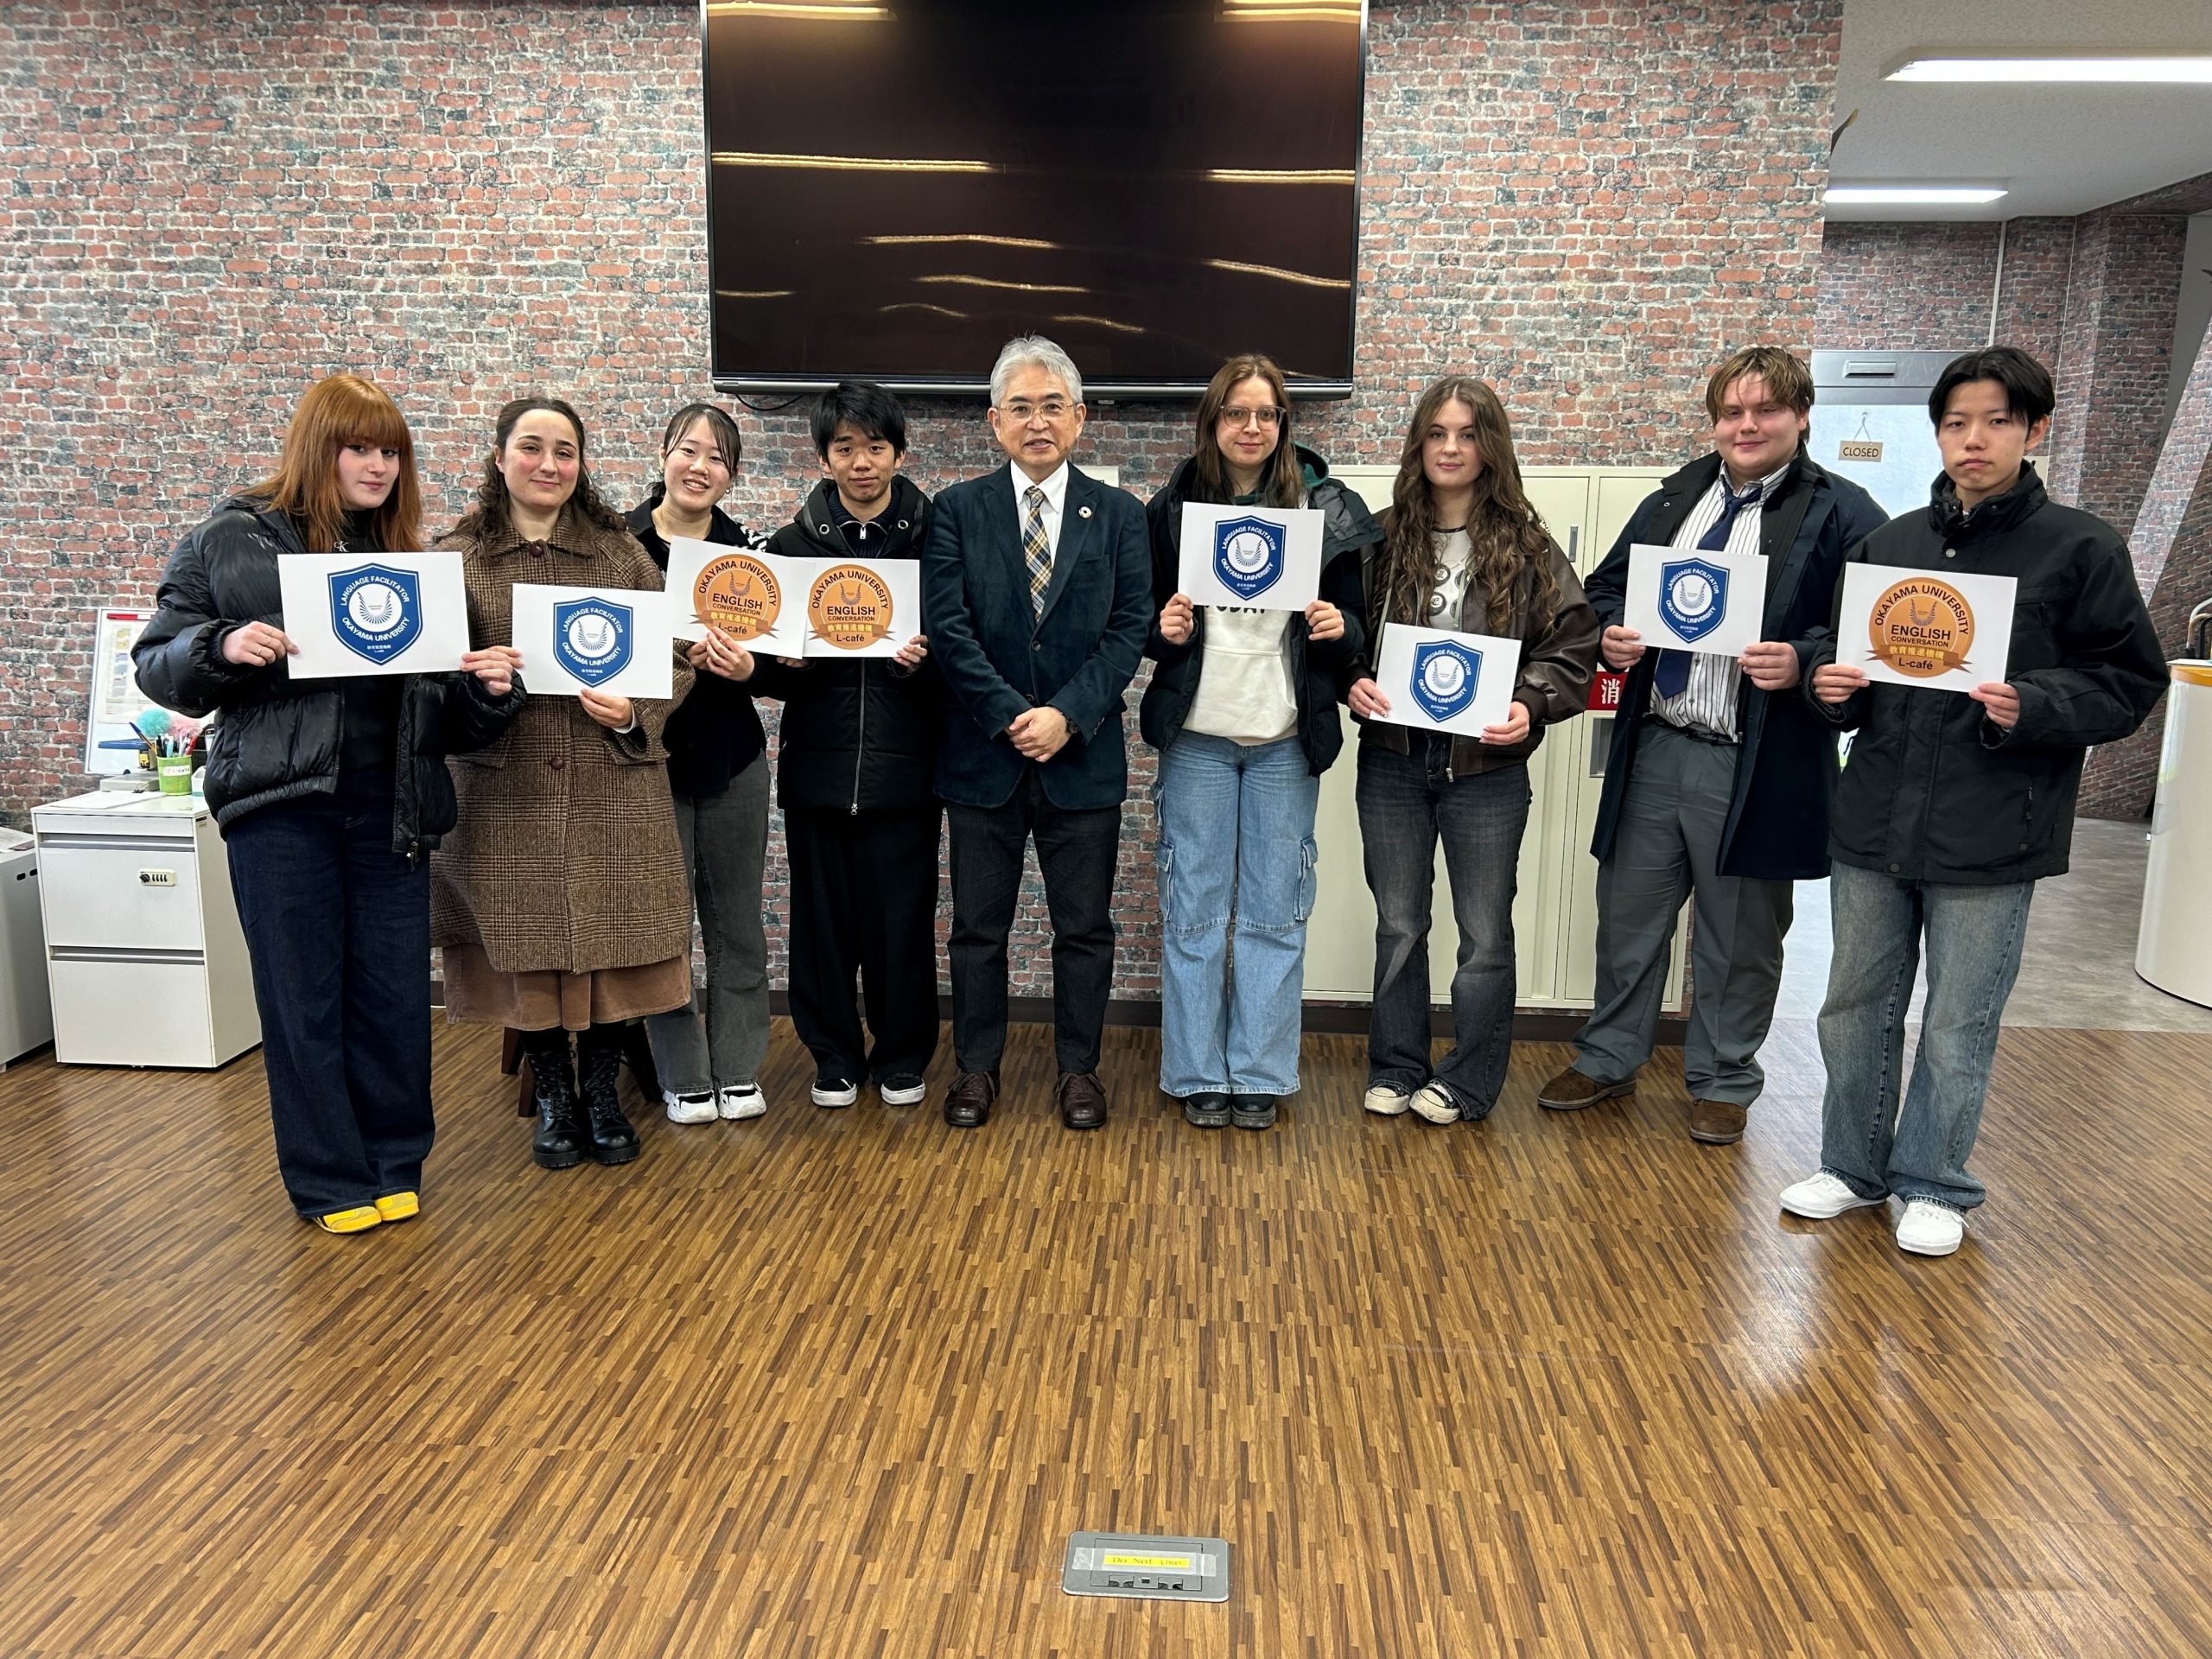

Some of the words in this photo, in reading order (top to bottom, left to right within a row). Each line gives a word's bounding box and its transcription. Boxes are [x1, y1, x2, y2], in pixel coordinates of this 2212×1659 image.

[1842, 447, 1879, 458] CLOSED
[1221, 525, 1247, 550] LANGUAGE
[1247, 525, 1276, 551] FACILITATOR
[1221, 557, 1243, 581] OKAYAMA
[1243, 562, 1274, 582] UNIVERSITY
[1668, 568, 1692, 591] LANGUAGE
[1692, 568, 1719, 594] FACILITATOR
[340, 576, 370, 606] LANGUAGE
[370, 575, 410, 603] FACILITATOR
[698, 560, 737, 594] OKAYAMA
[740, 560, 777, 607] UNIVERSITY
[812, 571, 845, 609] OKAYAMA
[847, 570, 888, 609] UNIVERSITY
[712, 593, 763, 610] ENGLISH
[712, 603, 761, 616] CONVERSATION
[827, 606, 875, 615] ENGLISH
[1665, 599, 1687, 623] OKAYAMA
[1687, 605, 1717, 624] UNIVERSITY
[1874, 585, 1919, 626] OKAYAMA
[1922, 584, 1969, 635] UNIVERSITY
[342, 616, 373, 642] OKAYAMA
[374, 616, 410, 642] UNIVERSITY
[562, 607, 589, 632] LANGUAGE
[590, 607, 623, 633] FACILITATOR
[718, 622, 747, 635] L-café
[1891, 624, 1951, 641] ENGLISH
[836, 633, 865, 642] L-café
[1891, 635, 1949, 648] CONVERSATION
[562, 641, 588, 666] OKAYAMA
[588, 645, 621, 666] UNIVERSITY
[1420, 649, 1446, 671] LANGUAGE
[1446, 649, 1471, 676] FACILITATOR
[1889, 645, 1944, 660] 教育推進機構
[1897, 658, 1933, 671] L-café
[1417, 678, 1438, 702] OKAYAMA
[1438, 686, 1467, 703] UNIVERSITY
[1601, 678, 1621, 705] 消
